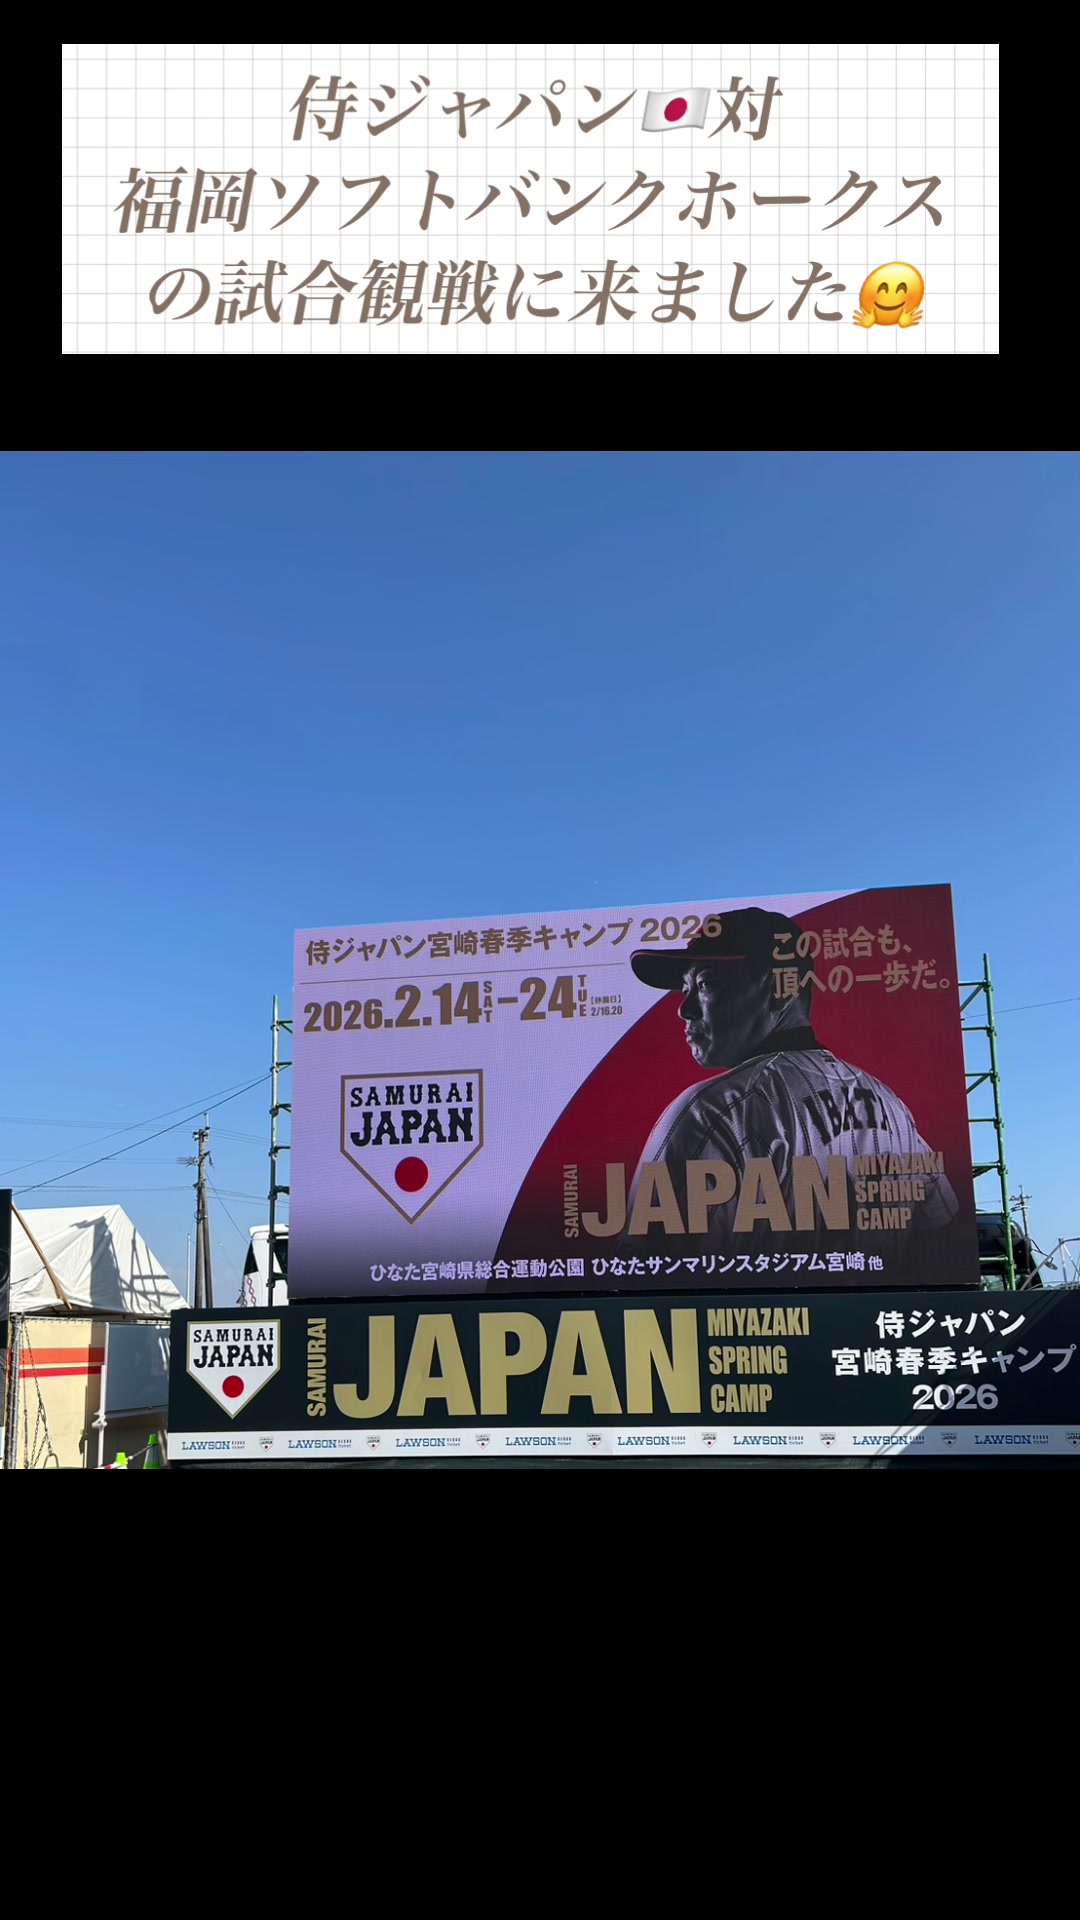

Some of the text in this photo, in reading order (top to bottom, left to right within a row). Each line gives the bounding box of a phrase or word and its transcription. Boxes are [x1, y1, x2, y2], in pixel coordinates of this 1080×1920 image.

[305, 914, 723, 966] 侍ジャパン宮崎春季キャンプ 2026
[772, 924, 914, 962] この試合も、
[772, 959, 951, 1000] 頂への一歩だ。
[303, 980, 483, 1033] 2026.2.14
[350, 1081, 474, 1108] SAMURAI
[350, 1106, 474, 1147] JAPAN
[853, 1151, 945, 1176] MIYAZAKI
[563, 1163, 579, 1238] SAMURAI
[581, 1155, 851, 1238] JAPAN
[854, 1179, 926, 1203] SPRING
[855, 1207, 913, 1231] CAMP
[370, 1251, 884, 1282] ひなた宮崎県総合運動公園 ひなたサンマリンスタジアム宮崎 他
[193, 1327, 275, 1343] SAMURAI
[706, 1306, 811, 1337] MIYAZAKI
[875, 1309, 1027, 1339] 侍ジャパン
[193, 1344, 275, 1368] JAPAN
[306, 1317, 328, 1417] SAMURAI
[332, 1309, 701, 1419] JAPAN
[707, 1345, 788, 1375] SPRING
[831, 1342, 1078, 1376] 宮崎春季キャンプ
[710, 1383, 774, 1413] CAMP
[912, 1383, 999, 1411] 2026
[181, 1440, 231, 1451] LAWSON
[287, 1439, 338, 1449] LAWSON
[395, 1438, 446, 1448] LAWSON
[505, 1436, 557, 1446] LAWSON
[617, 1435, 671, 1446] LAWSON
[732, 1435, 788, 1445] LAWSON
[852, 1435, 908, 1445] LAWSON
[974, 1434, 1032, 1445] LAWSON
